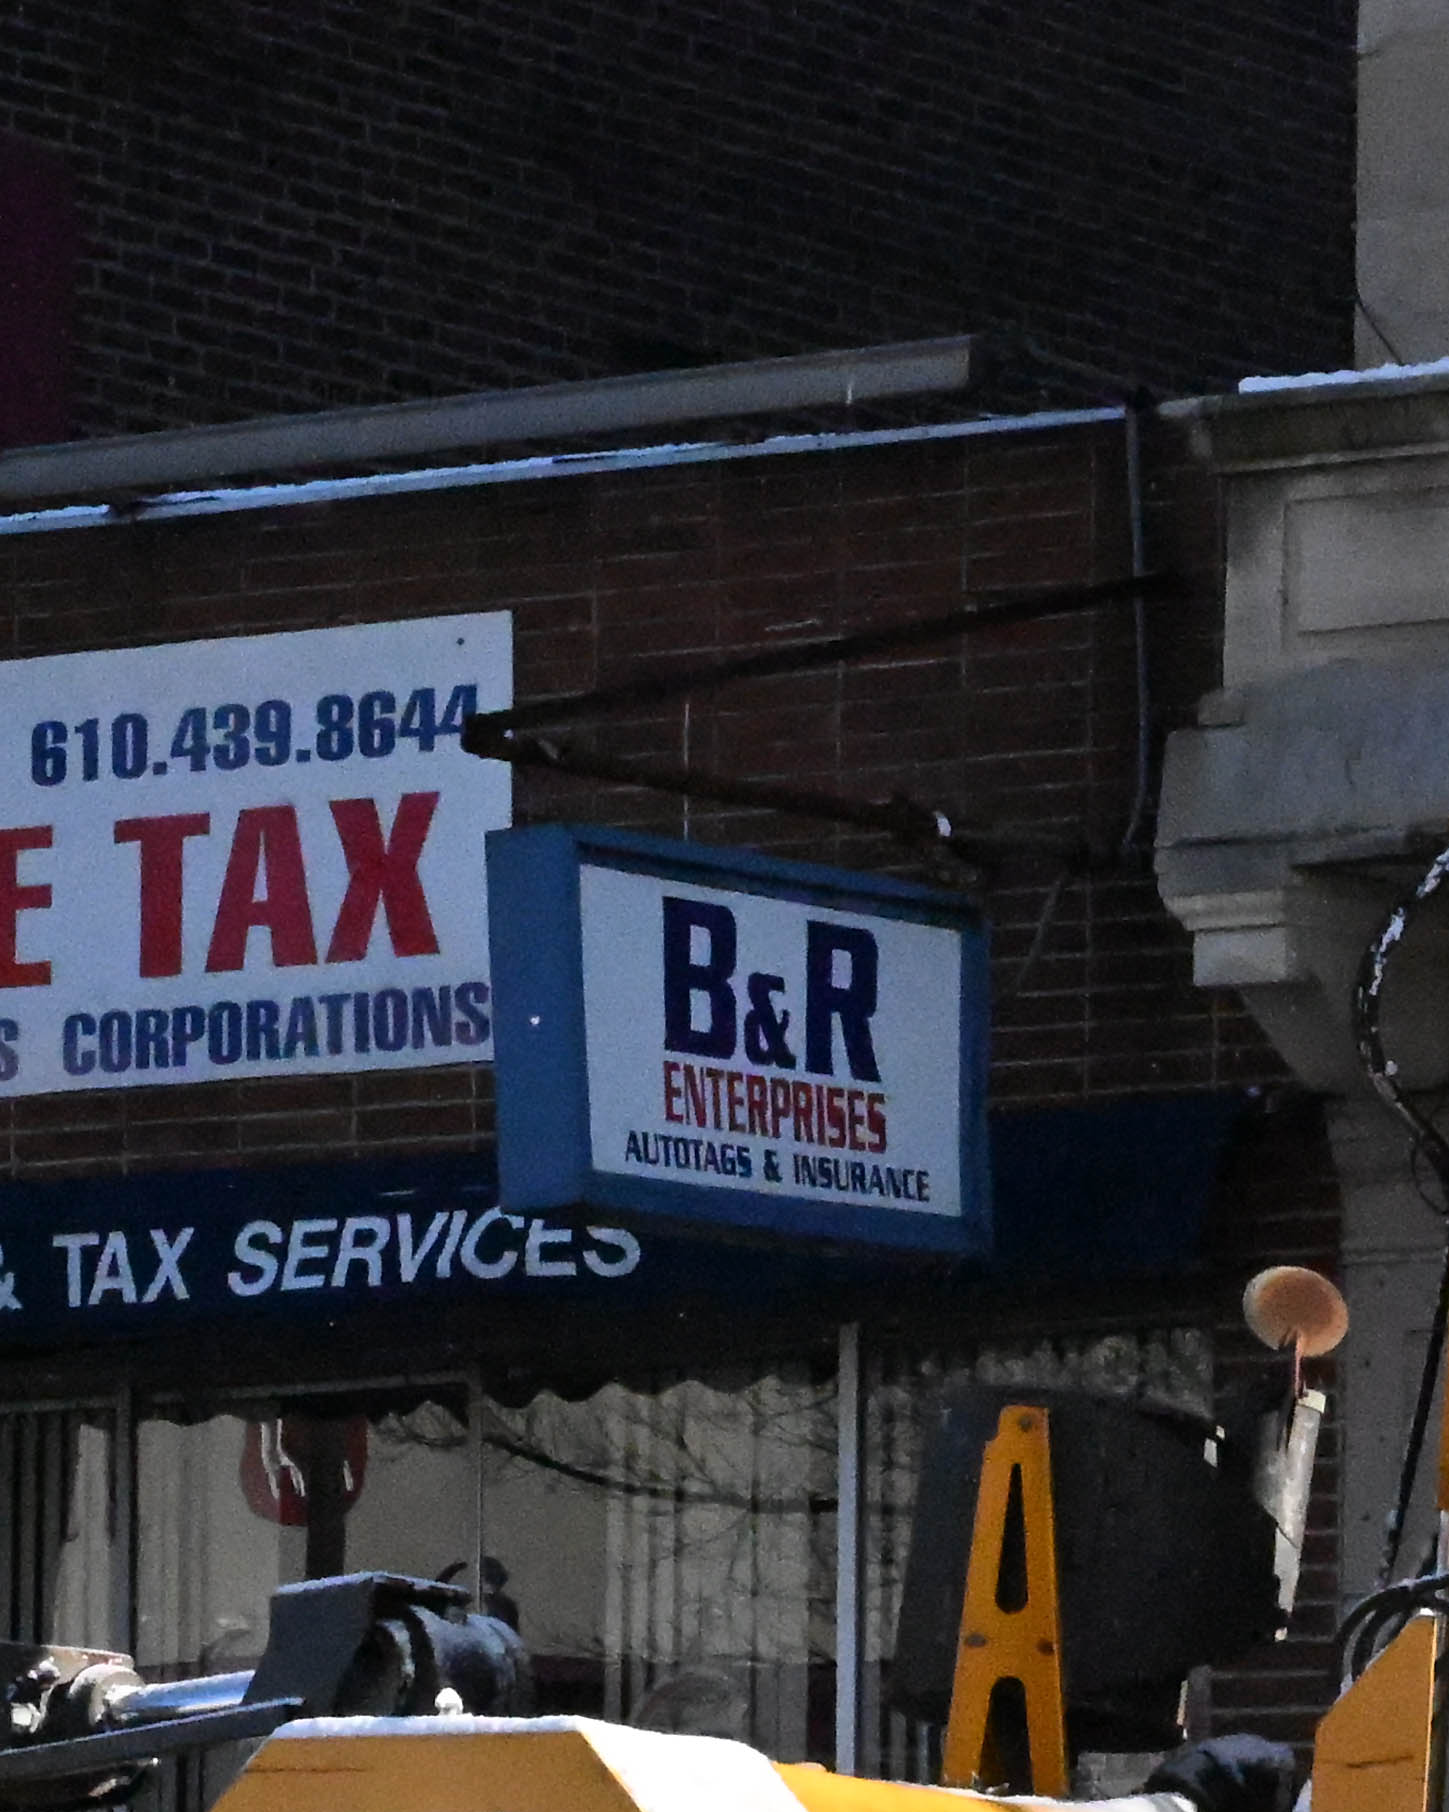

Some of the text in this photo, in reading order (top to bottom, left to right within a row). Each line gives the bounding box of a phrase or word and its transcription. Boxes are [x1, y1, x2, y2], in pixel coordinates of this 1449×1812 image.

[30, 683, 479, 786] 610.439.8644
[114, 792, 442, 979] TAX
[63, 982, 494, 1077] CORPORATIONS
[662, 896, 882, 1082] B&R
[663, 1061, 888, 1155] ENTERPRISES
[624, 1130, 931, 1203] AUTOTAGS & INSURANCE
[52, 1227, 195, 1308] TAX
[227, 1206, 642, 1298] SERVICES
